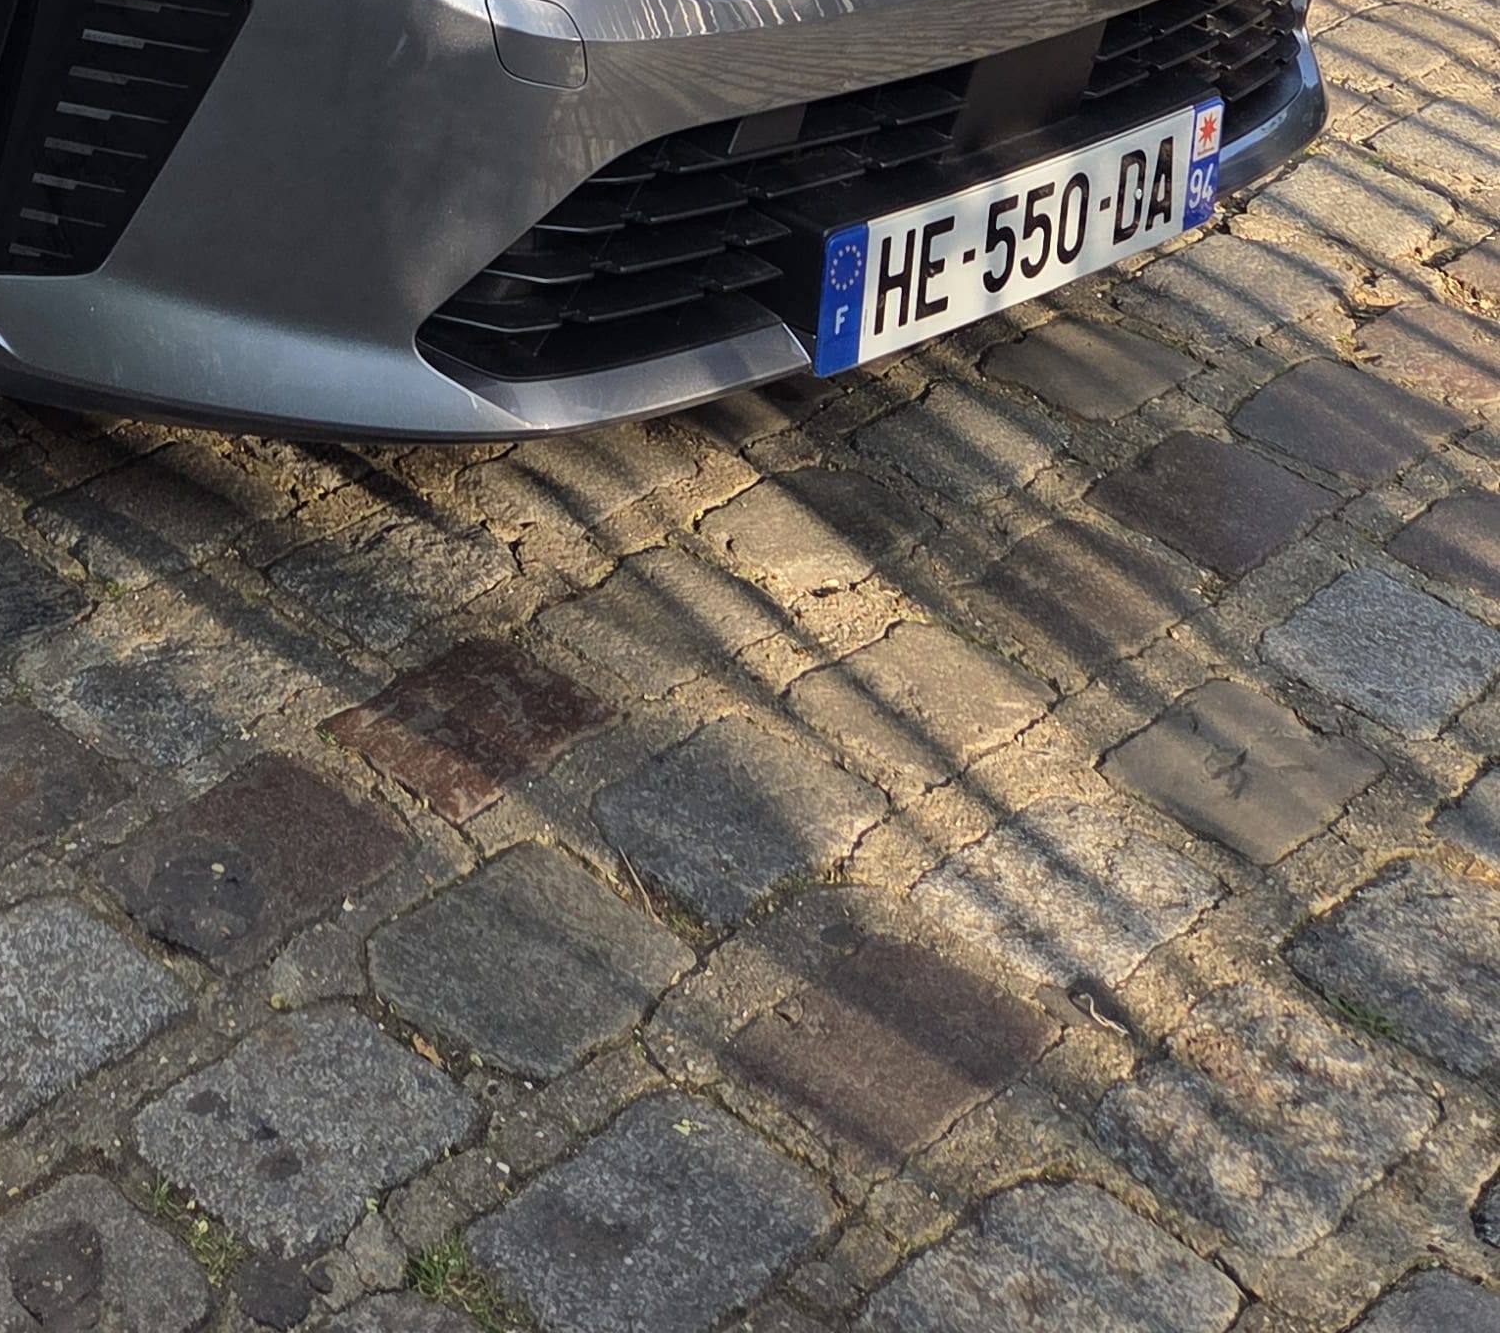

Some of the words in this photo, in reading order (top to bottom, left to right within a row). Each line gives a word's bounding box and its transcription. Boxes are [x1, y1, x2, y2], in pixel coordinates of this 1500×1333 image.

[1188, 163, 1215, 210] 94
[873, 135, 1175, 336] HE-550-DA
[834, 304, 851, 336] F
